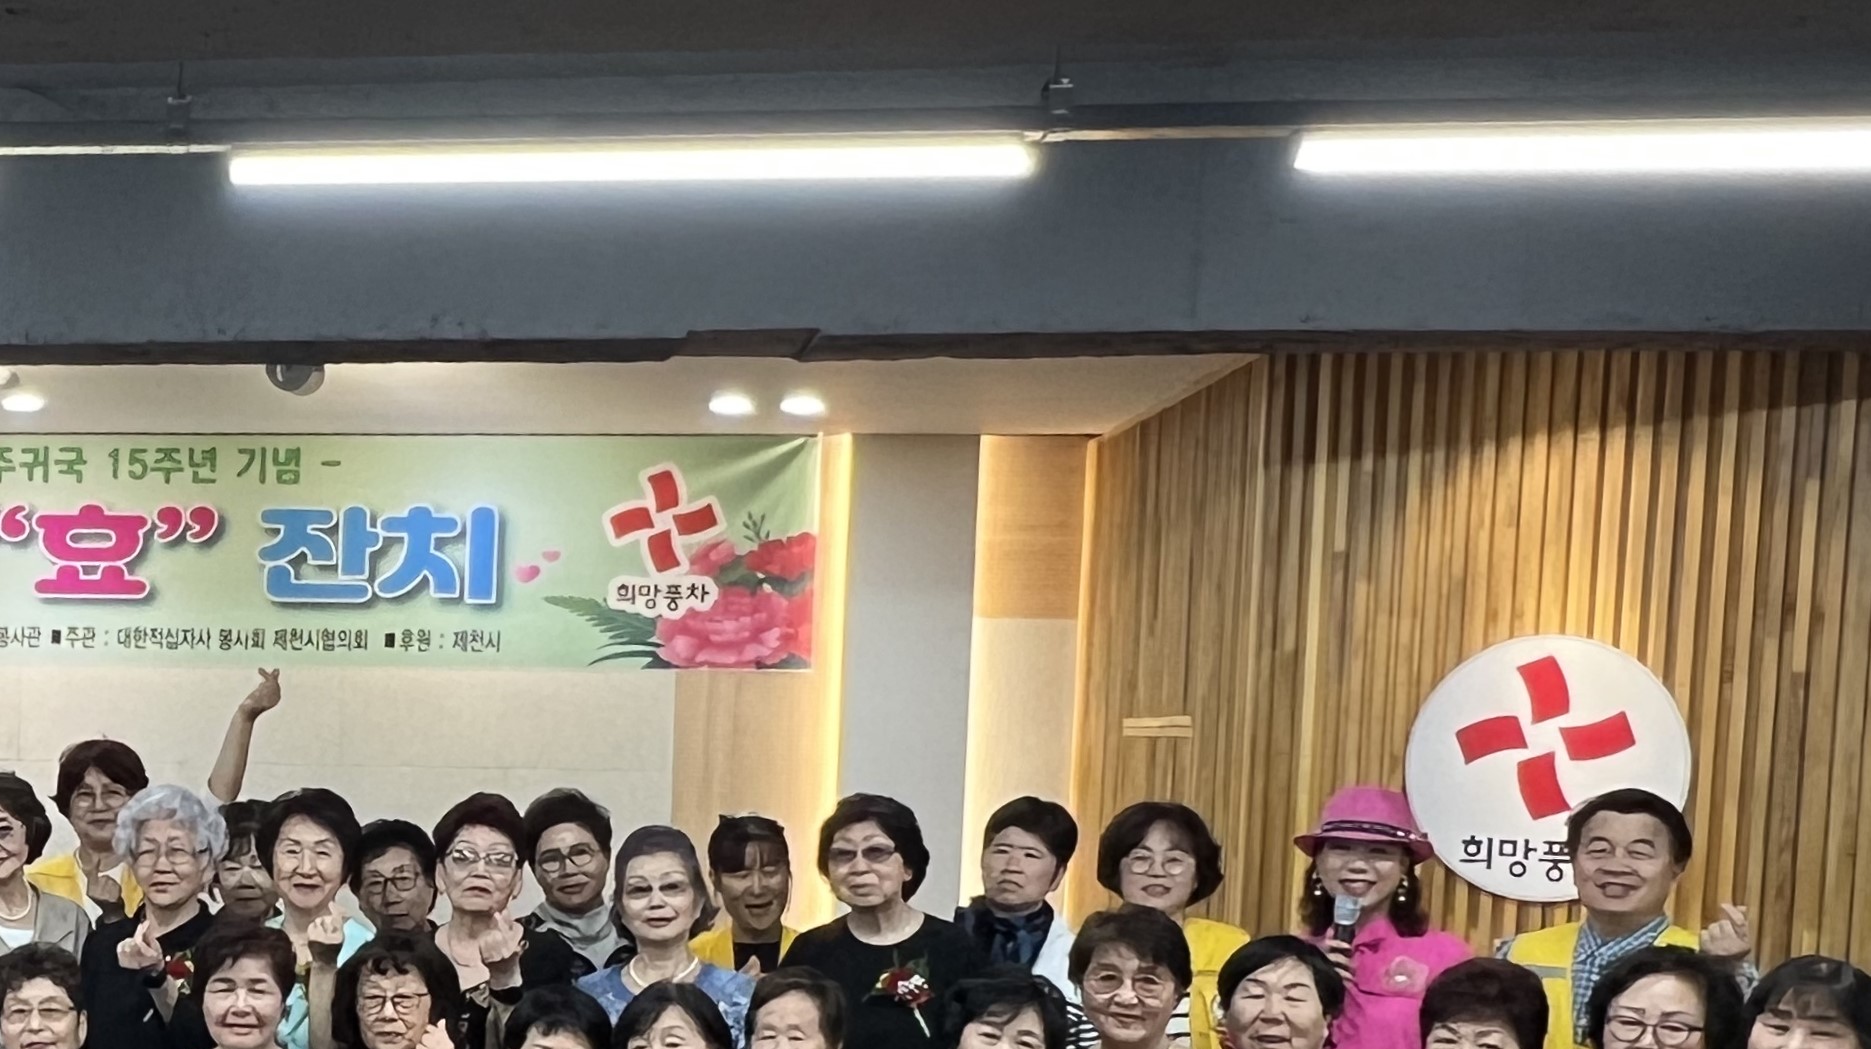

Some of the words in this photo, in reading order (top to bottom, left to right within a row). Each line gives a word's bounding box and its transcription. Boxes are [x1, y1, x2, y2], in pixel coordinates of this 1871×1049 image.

[108, 447, 218, 485] 15주년
[236, 446, 301, 485] 기념
[257, 504, 500, 604] 잔치
[615, 582, 711, 612] 희망풍차
[116, 625, 211, 650] 대한적십자사
[451, 629, 501, 653] 제천시
[1458, 834, 1574, 883] 희망풍
